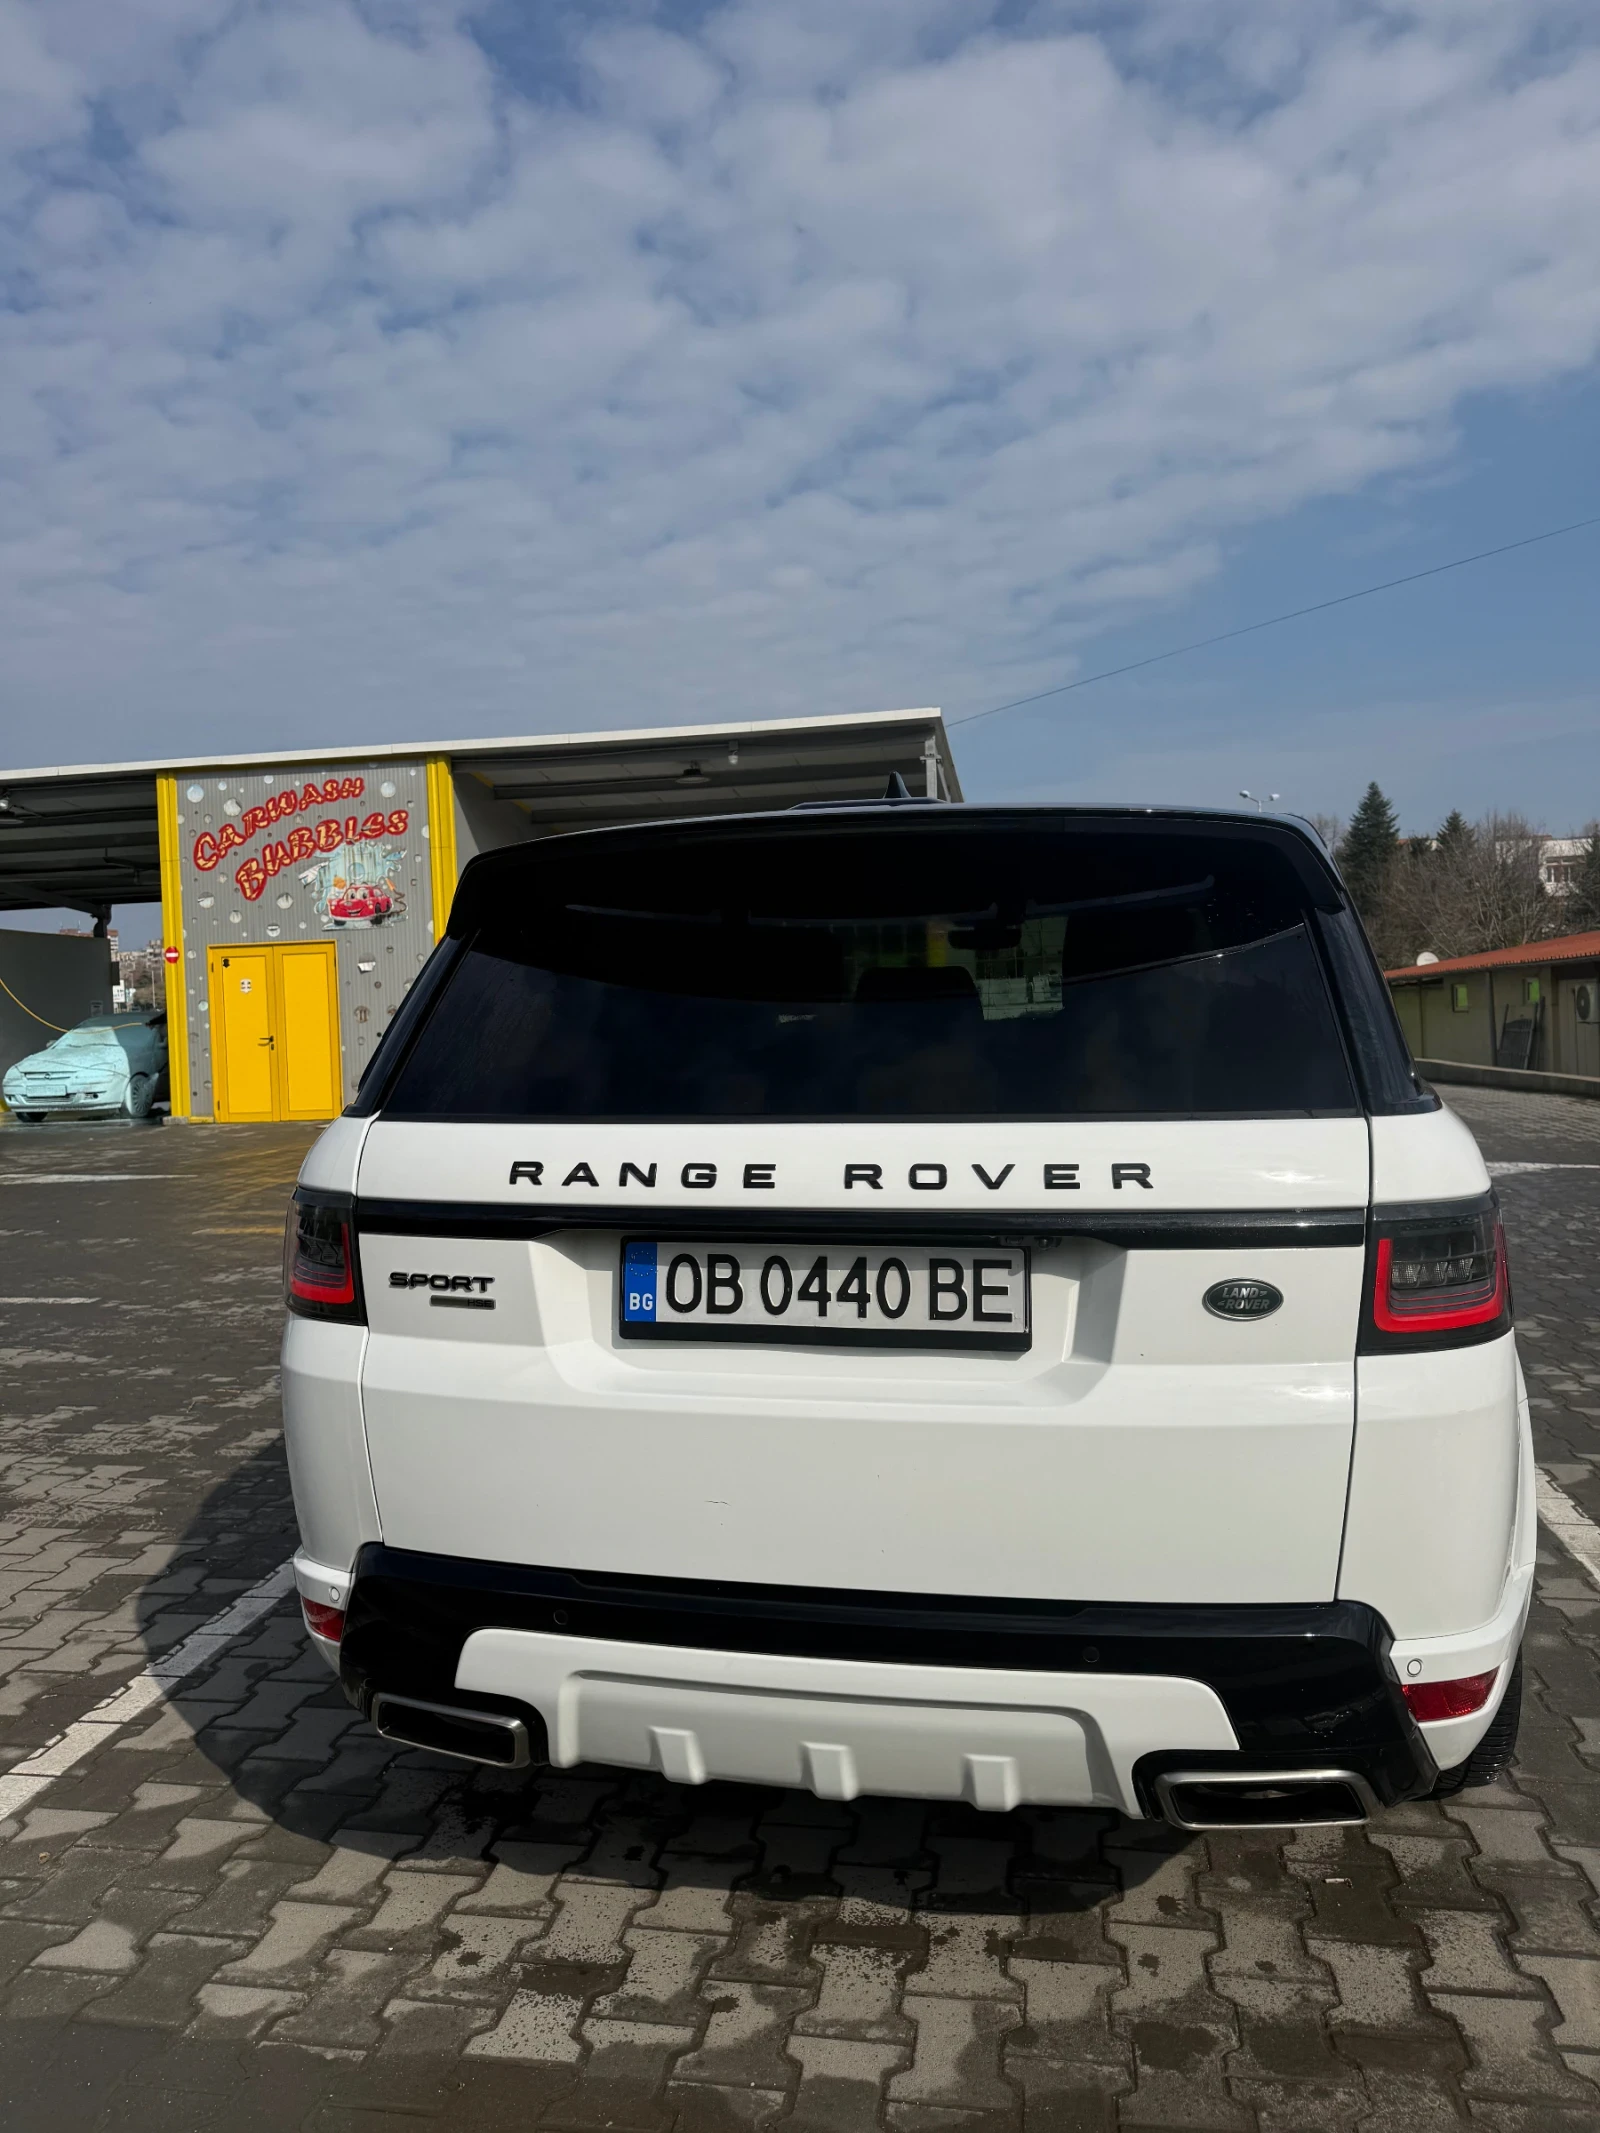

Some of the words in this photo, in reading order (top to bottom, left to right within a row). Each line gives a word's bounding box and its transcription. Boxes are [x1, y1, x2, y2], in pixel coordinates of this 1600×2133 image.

[194, 777, 365, 871] CARWASH
[236, 810, 409, 901] BUBBLES
[509, 1160, 777, 1189] RANGE
[843, 1163, 1155, 1190] ROVER
[389, 1271, 495, 1292] SPORT
[666, 1253, 744, 1314] OB
[760, 1255, 911, 1319] 0440
[929, 1258, 1013, 1323] BE
[629, 1293, 653, 1311] BG
[1222, 1287, 1259, 1298] LAND
[467, 1299, 493, 1308] HSE
[1225, 1299, 1270, 1310] ROVER
